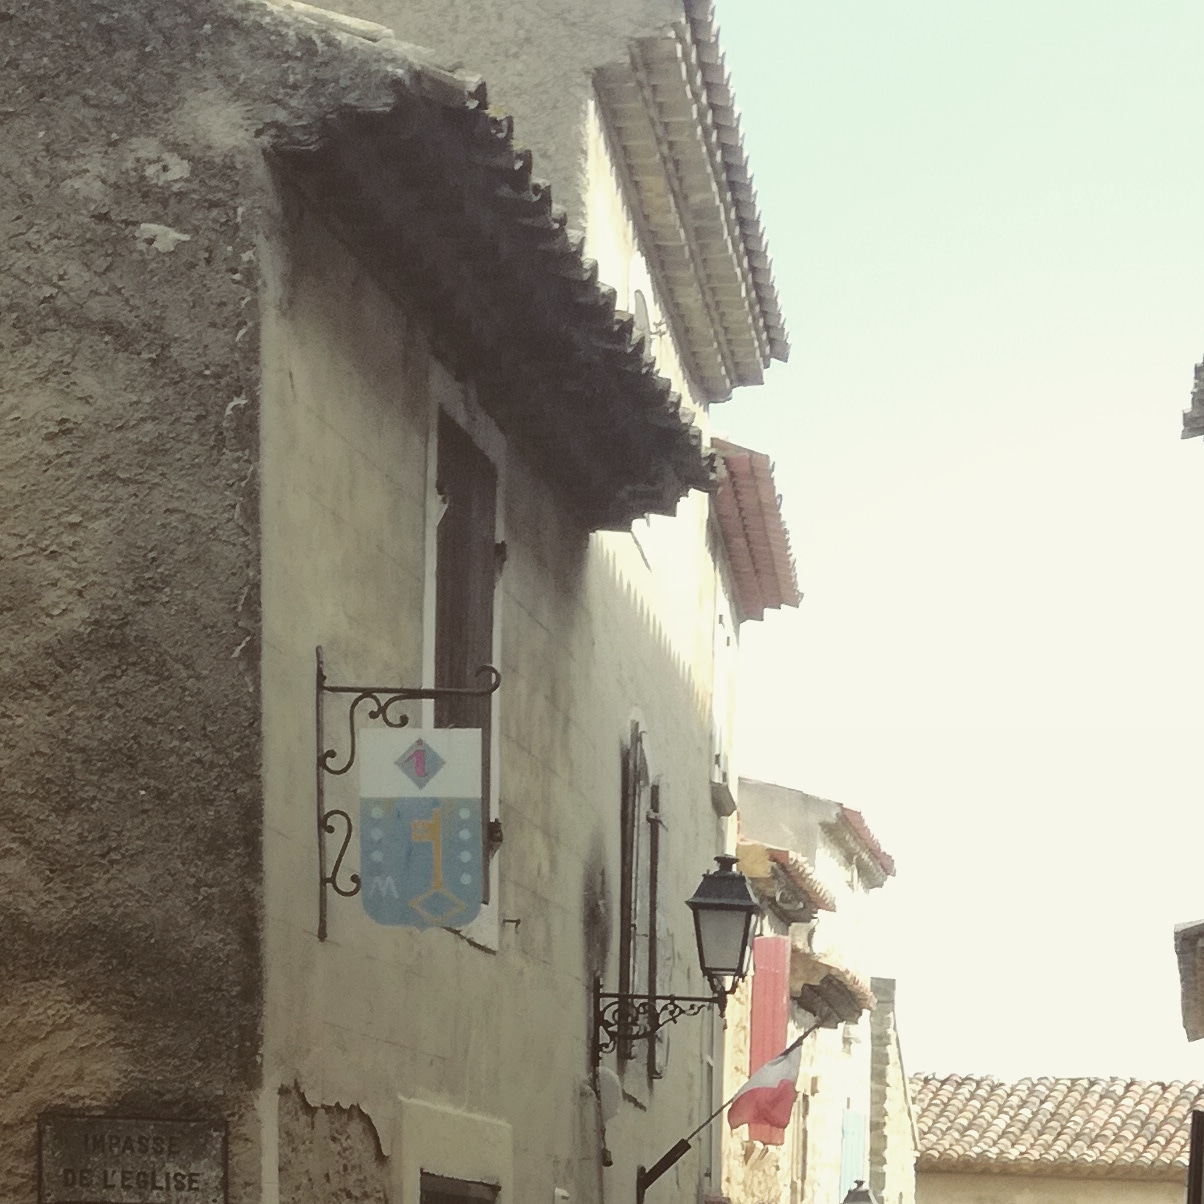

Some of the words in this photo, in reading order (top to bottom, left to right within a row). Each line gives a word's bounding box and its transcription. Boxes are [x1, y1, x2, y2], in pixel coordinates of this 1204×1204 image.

[83, 1133, 181, 1154] IMPASSE
[63, 1168, 91, 1188] DE
[103, 1169, 201, 1192] L'EGLISE
